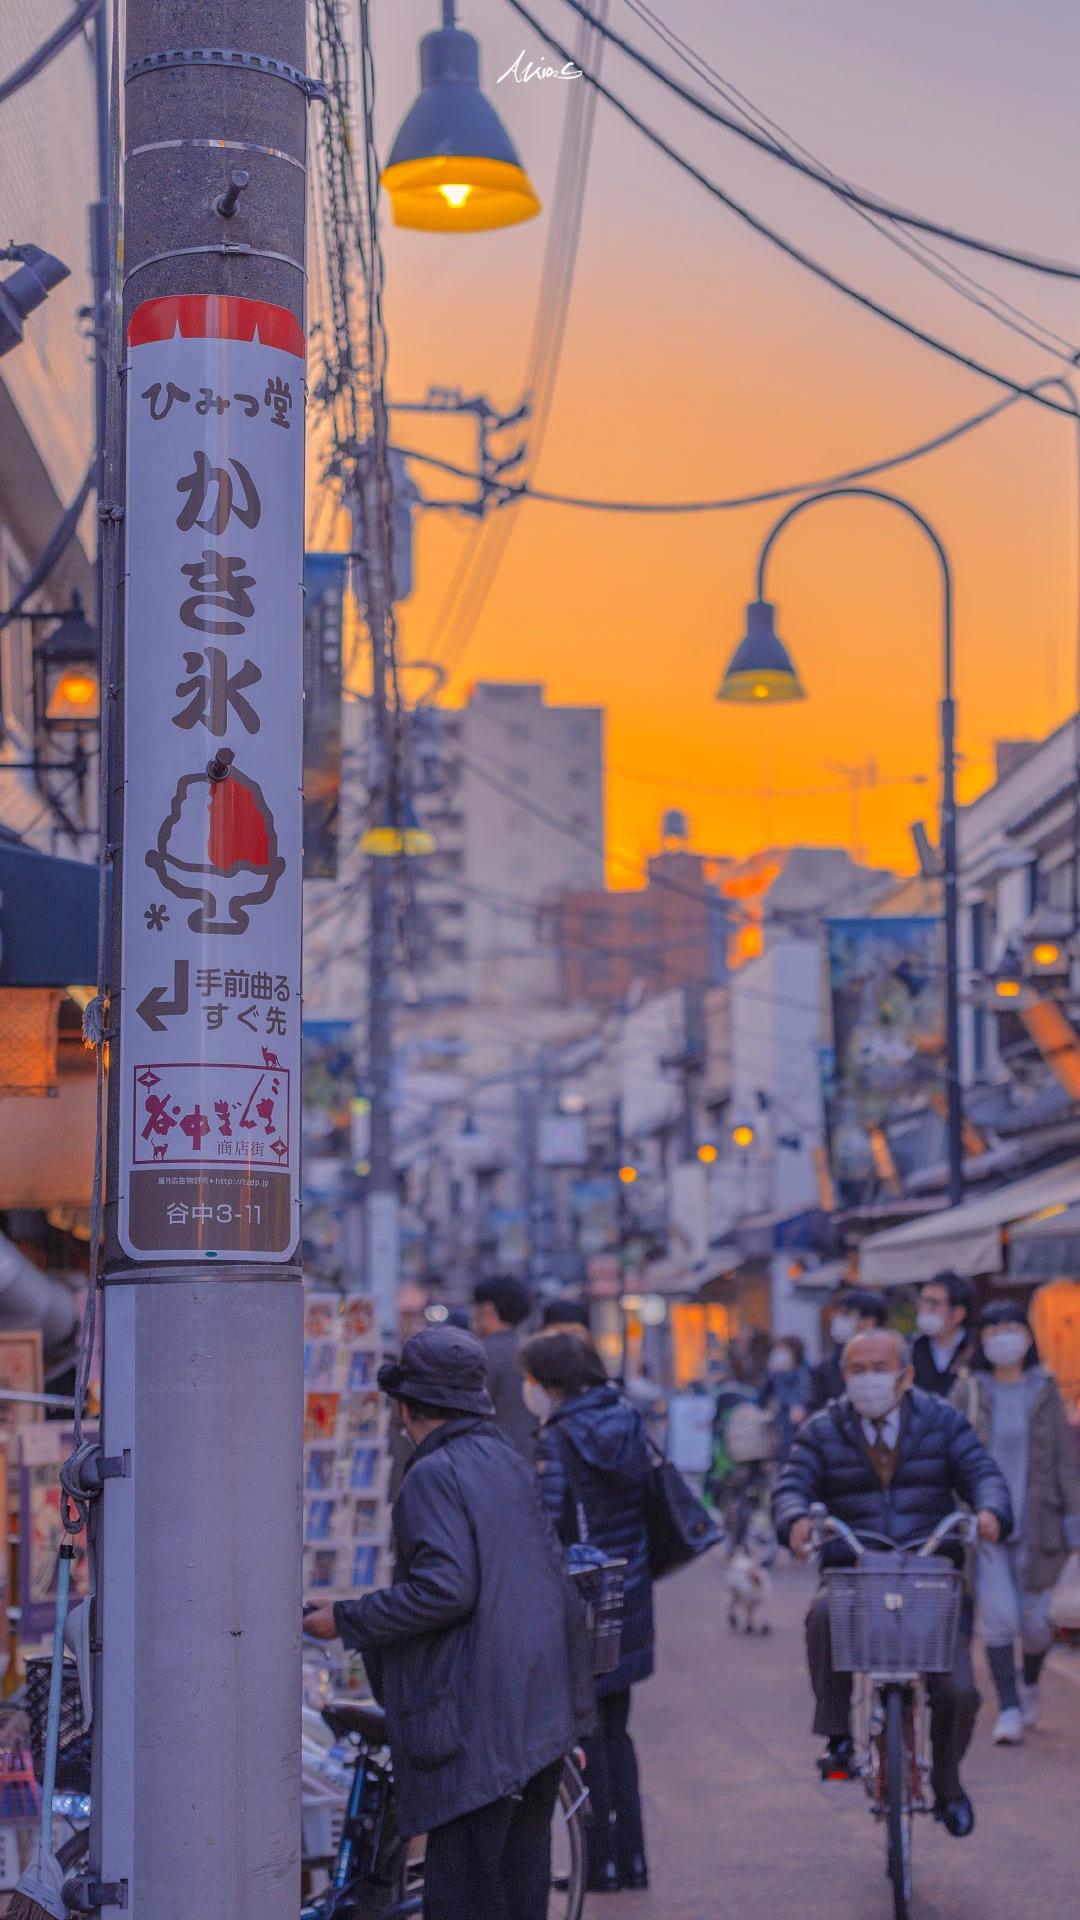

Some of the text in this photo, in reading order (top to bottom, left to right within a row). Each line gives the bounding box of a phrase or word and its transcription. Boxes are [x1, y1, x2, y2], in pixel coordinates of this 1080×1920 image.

[141, 376, 293, 429] ひみつ堂
[172, 450, 262, 737] かき氷
[196, 968, 290, 1002] 手前曲る
[202, 1002, 287, 1036] すぐ先
[141, 1073, 281, 1151] 谷中ぎんざ
[217, 1138, 265, 1158] 商店街
[166, 1202, 262, 1225] 谷中3-11
